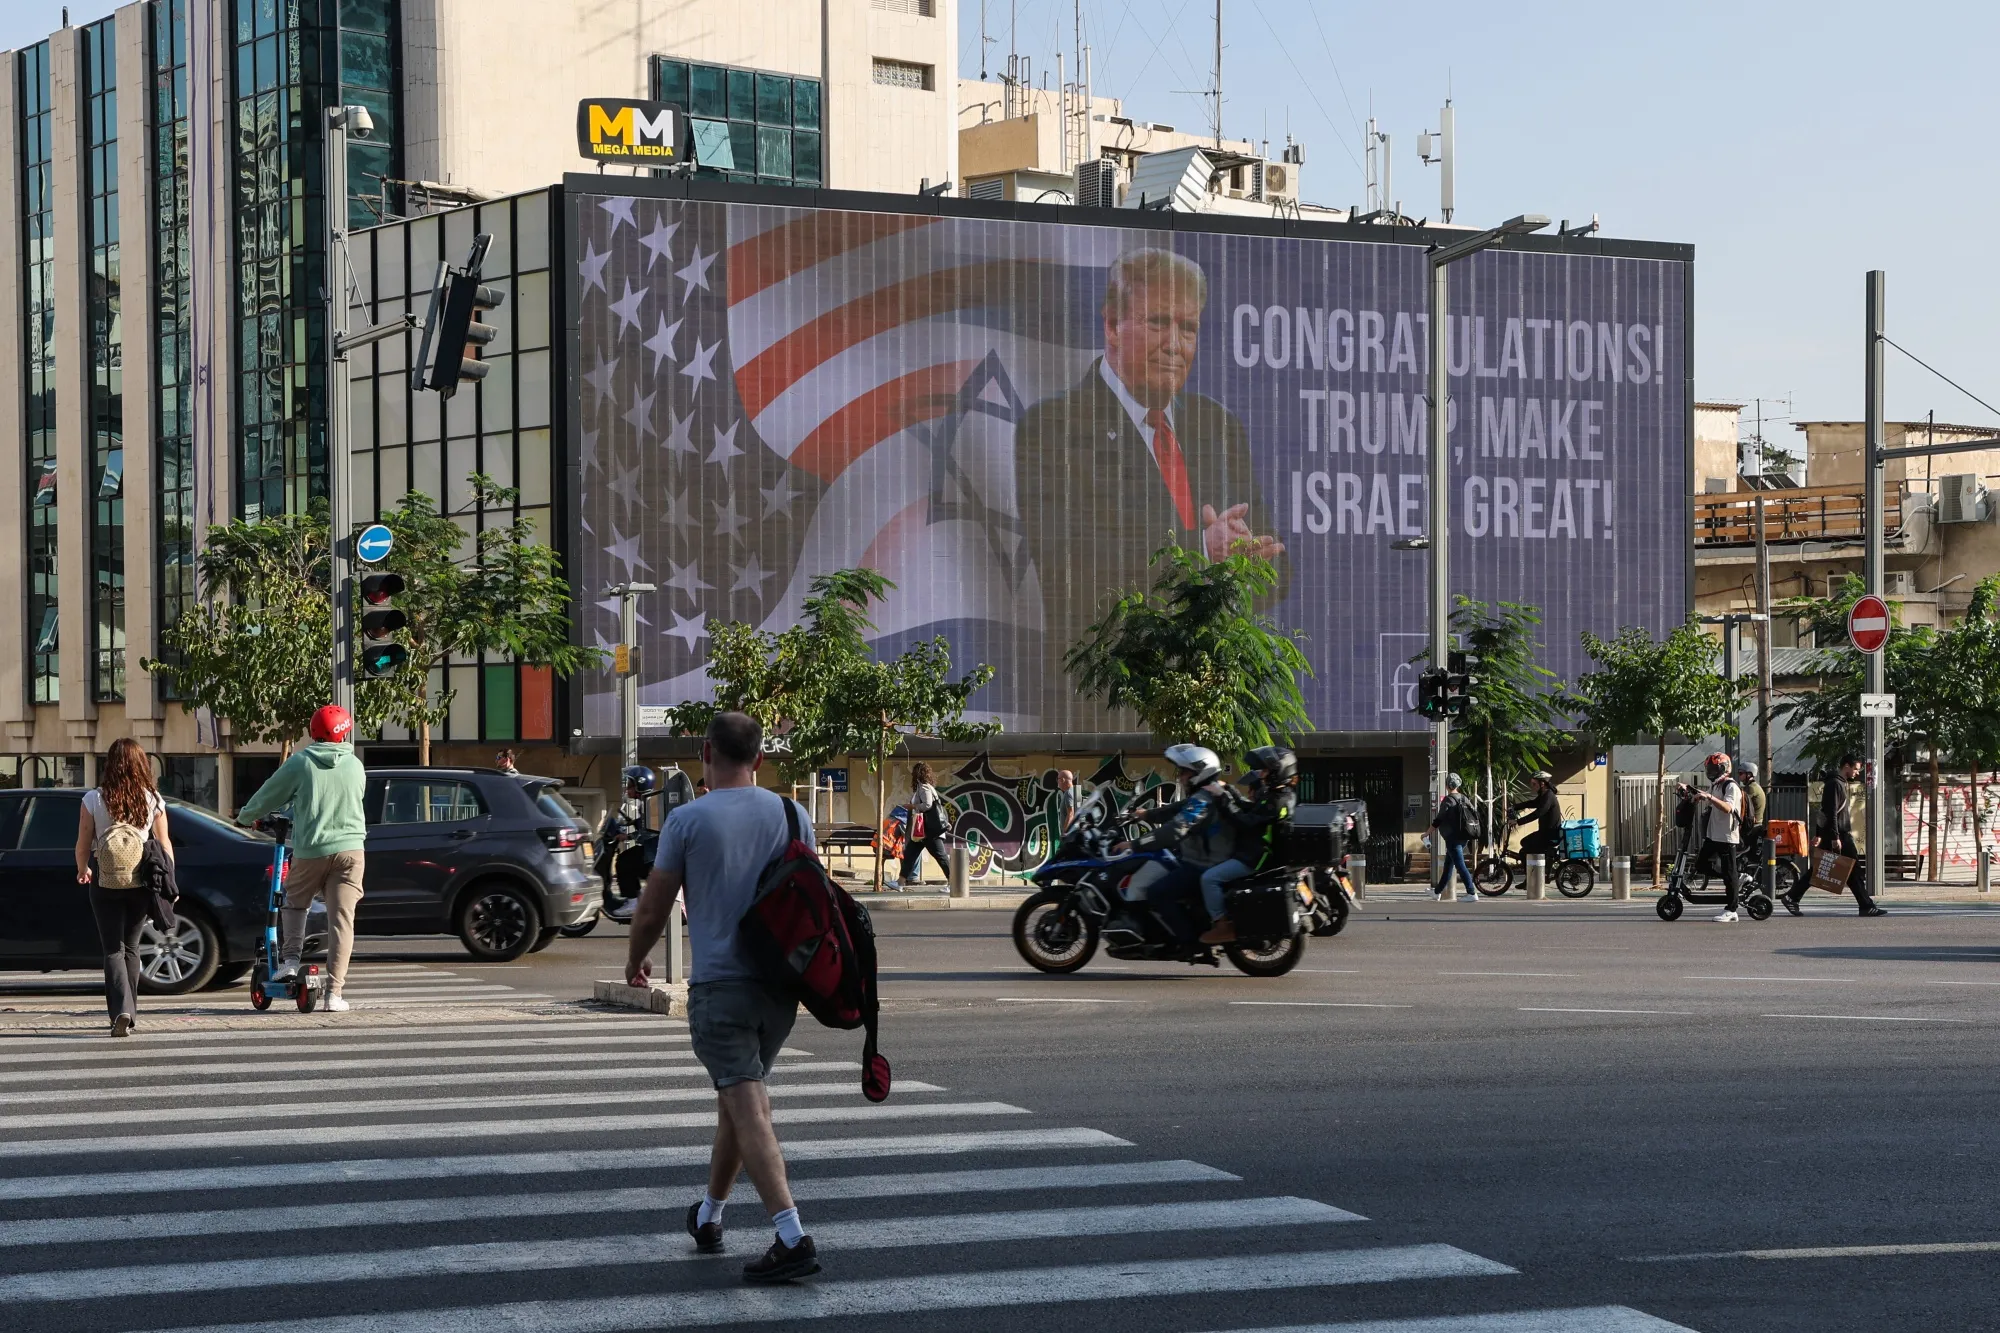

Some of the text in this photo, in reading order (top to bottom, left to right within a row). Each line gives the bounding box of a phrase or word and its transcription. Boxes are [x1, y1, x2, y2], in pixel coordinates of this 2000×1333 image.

[589, 104, 674, 147] MM
[593, 143, 673, 156] MEGA MEDIA
[1233, 303, 1664, 385] CONGRATULATIONS!
[1481, 396, 1604, 461] MAKE
[1464, 475, 1613, 540] GREAT!
[1820, 860, 1836, 868] BEST
[1823, 852, 1839, 860] ONLY
[1815, 874, 1842, 885] ATHLETE
